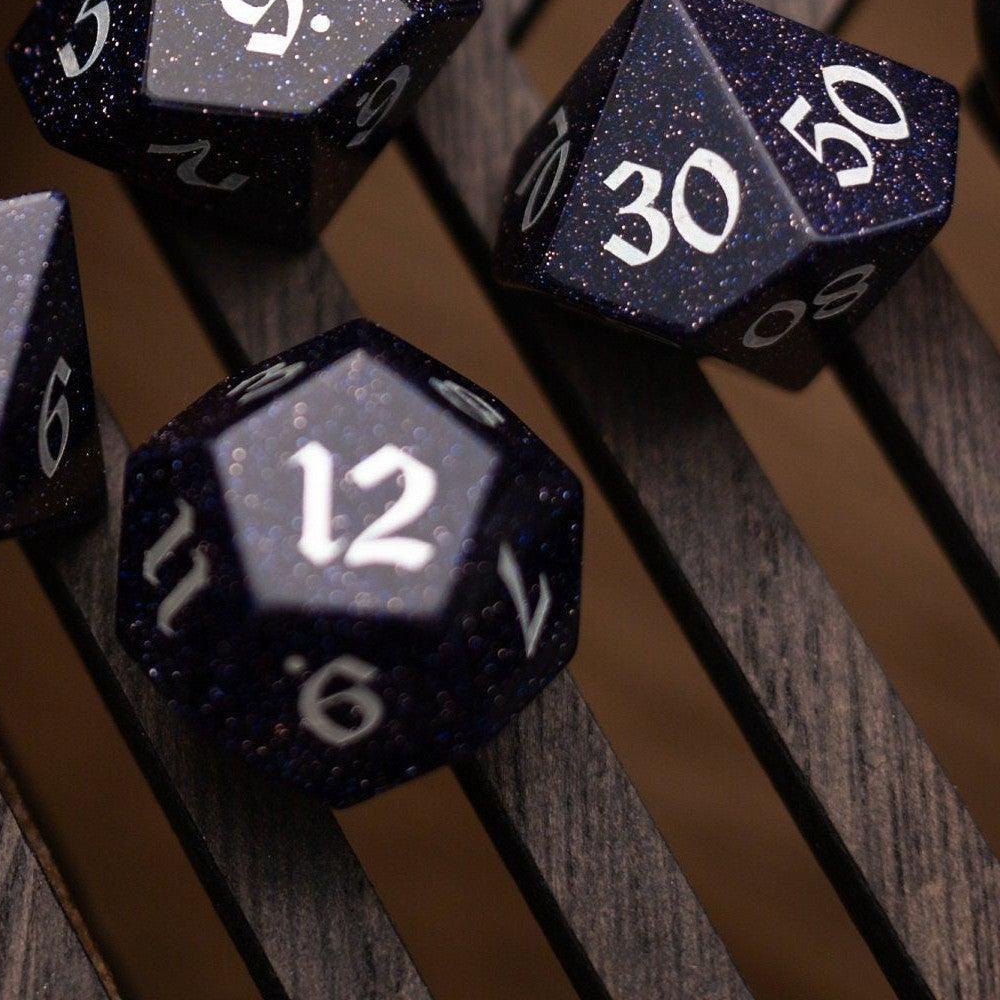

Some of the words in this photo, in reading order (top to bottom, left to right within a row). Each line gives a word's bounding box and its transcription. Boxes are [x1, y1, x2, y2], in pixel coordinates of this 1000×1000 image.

[148, 139, 250, 191] 2
[780, 64, 910, 187] 50
[603, 148, 740, 266] 30
[743, 263, 876, 348] 80
[38, 355, 72, 479] 6
[288, 441, 437, 572] 12
[142, 499, 210, 637] 11
[498, 540, 553, 658] 7
